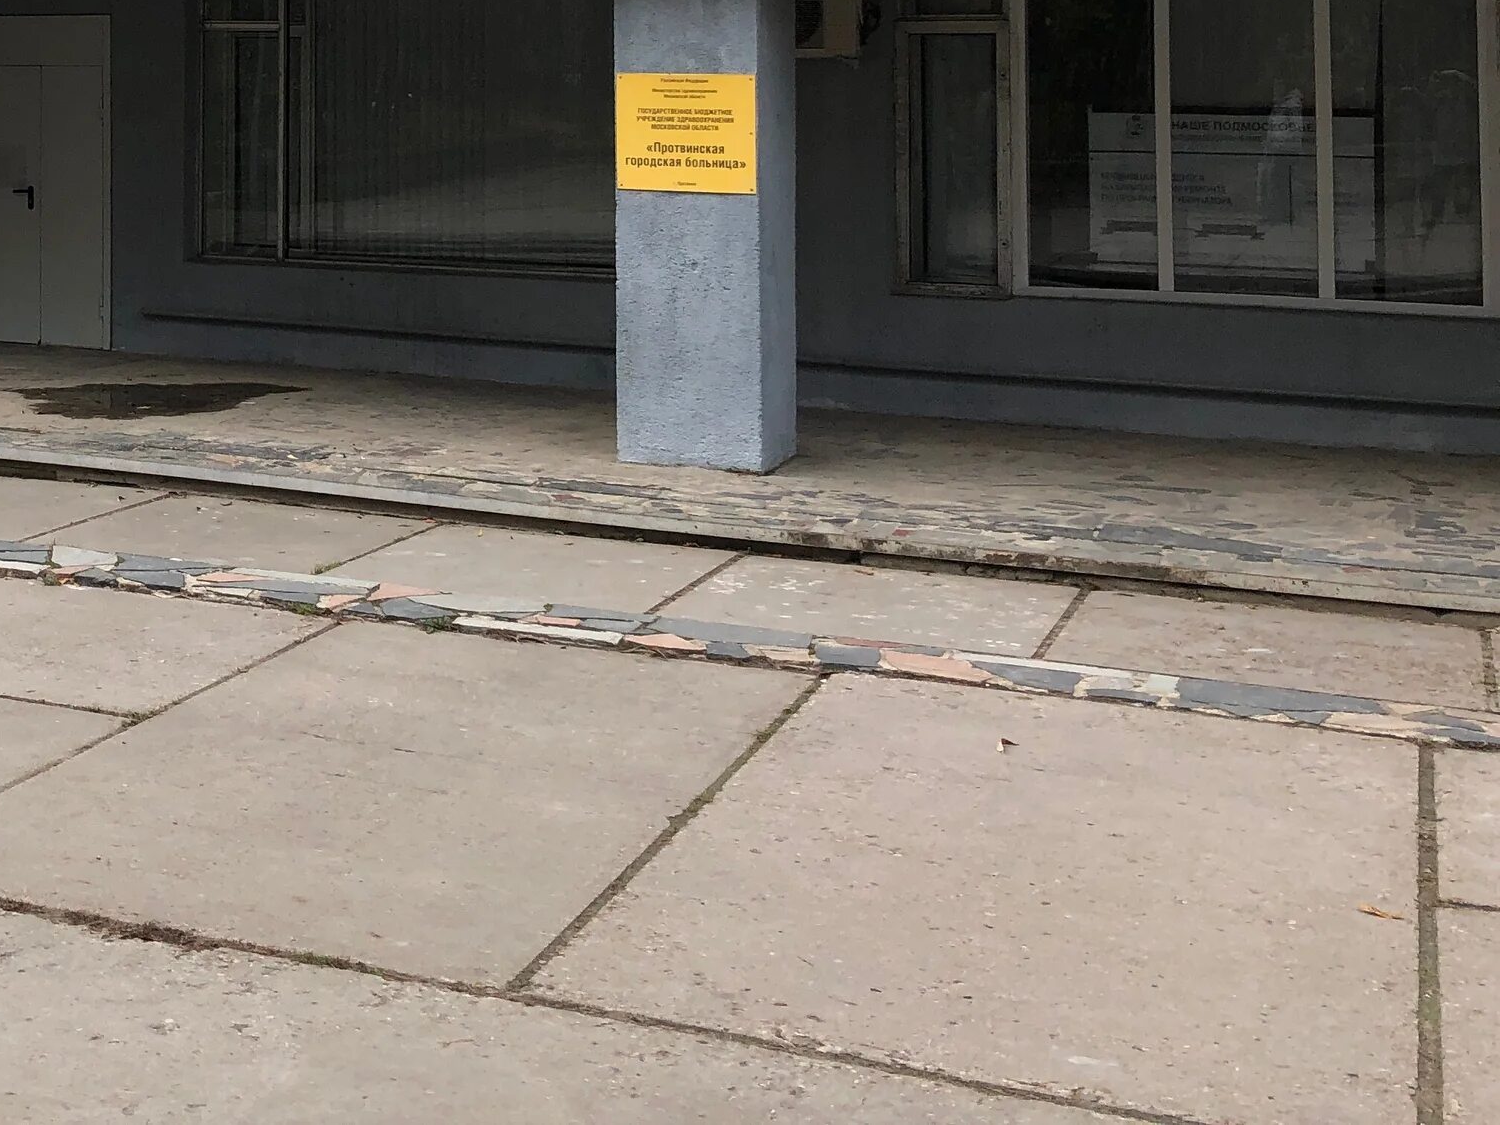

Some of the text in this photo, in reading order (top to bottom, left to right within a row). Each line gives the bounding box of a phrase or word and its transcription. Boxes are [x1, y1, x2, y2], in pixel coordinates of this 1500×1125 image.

[646, 141, 725, 155] «Протвинская
[625, 156, 747, 170] городская больница»
